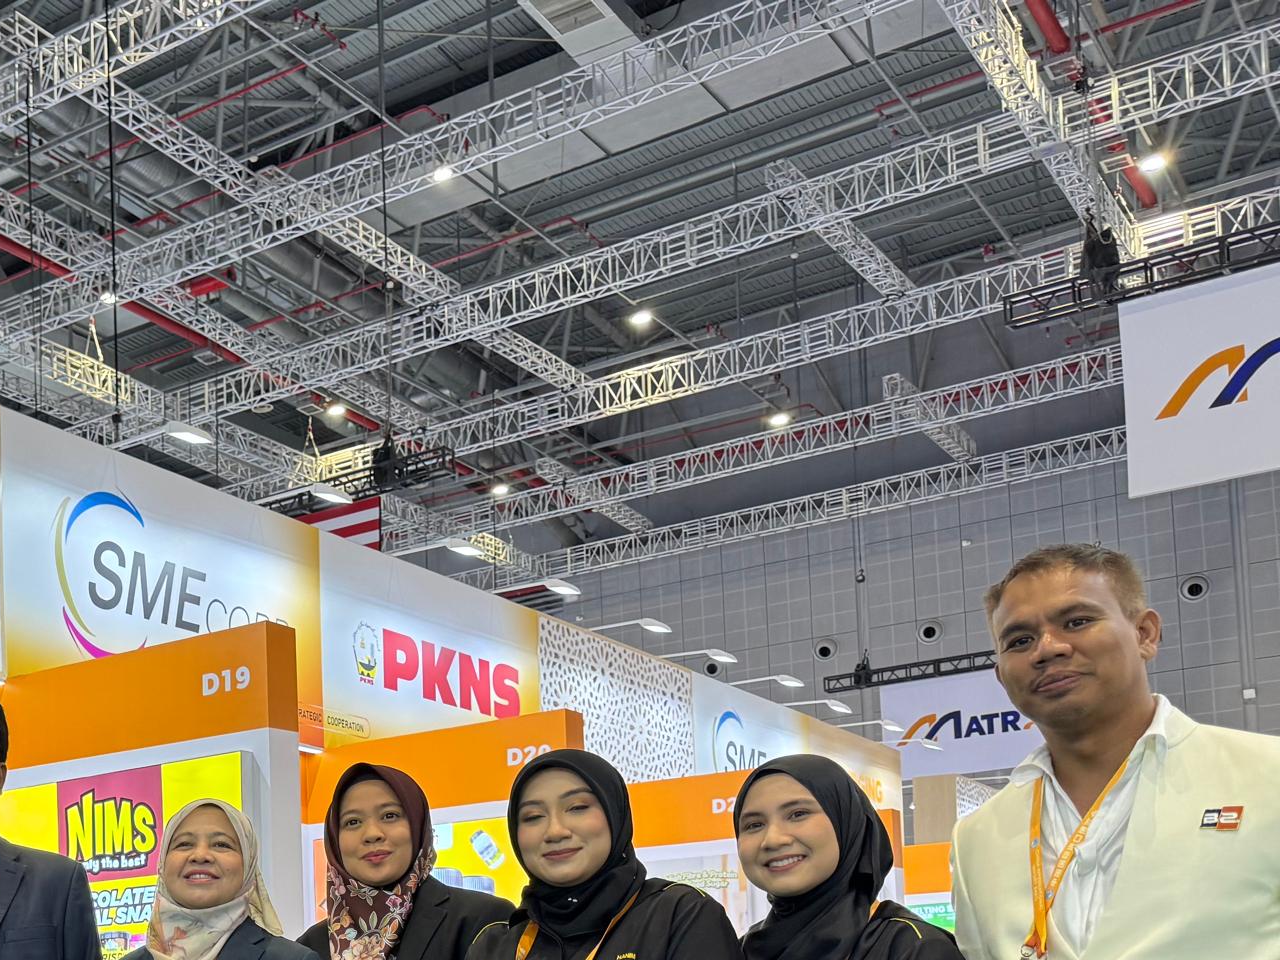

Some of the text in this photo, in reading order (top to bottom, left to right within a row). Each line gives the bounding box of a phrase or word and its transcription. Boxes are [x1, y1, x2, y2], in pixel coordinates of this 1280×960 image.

[202, 666, 251, 696] D19
[382, 628, 521, 720] PKNS
[326, 715, 365, 733] COOPERATION
[896, 710, 1035, 747] MATR
[65, 789, 156, 862] NIMS
[101, 856, 119, 869] the
[121, 854, 146, 868] best
